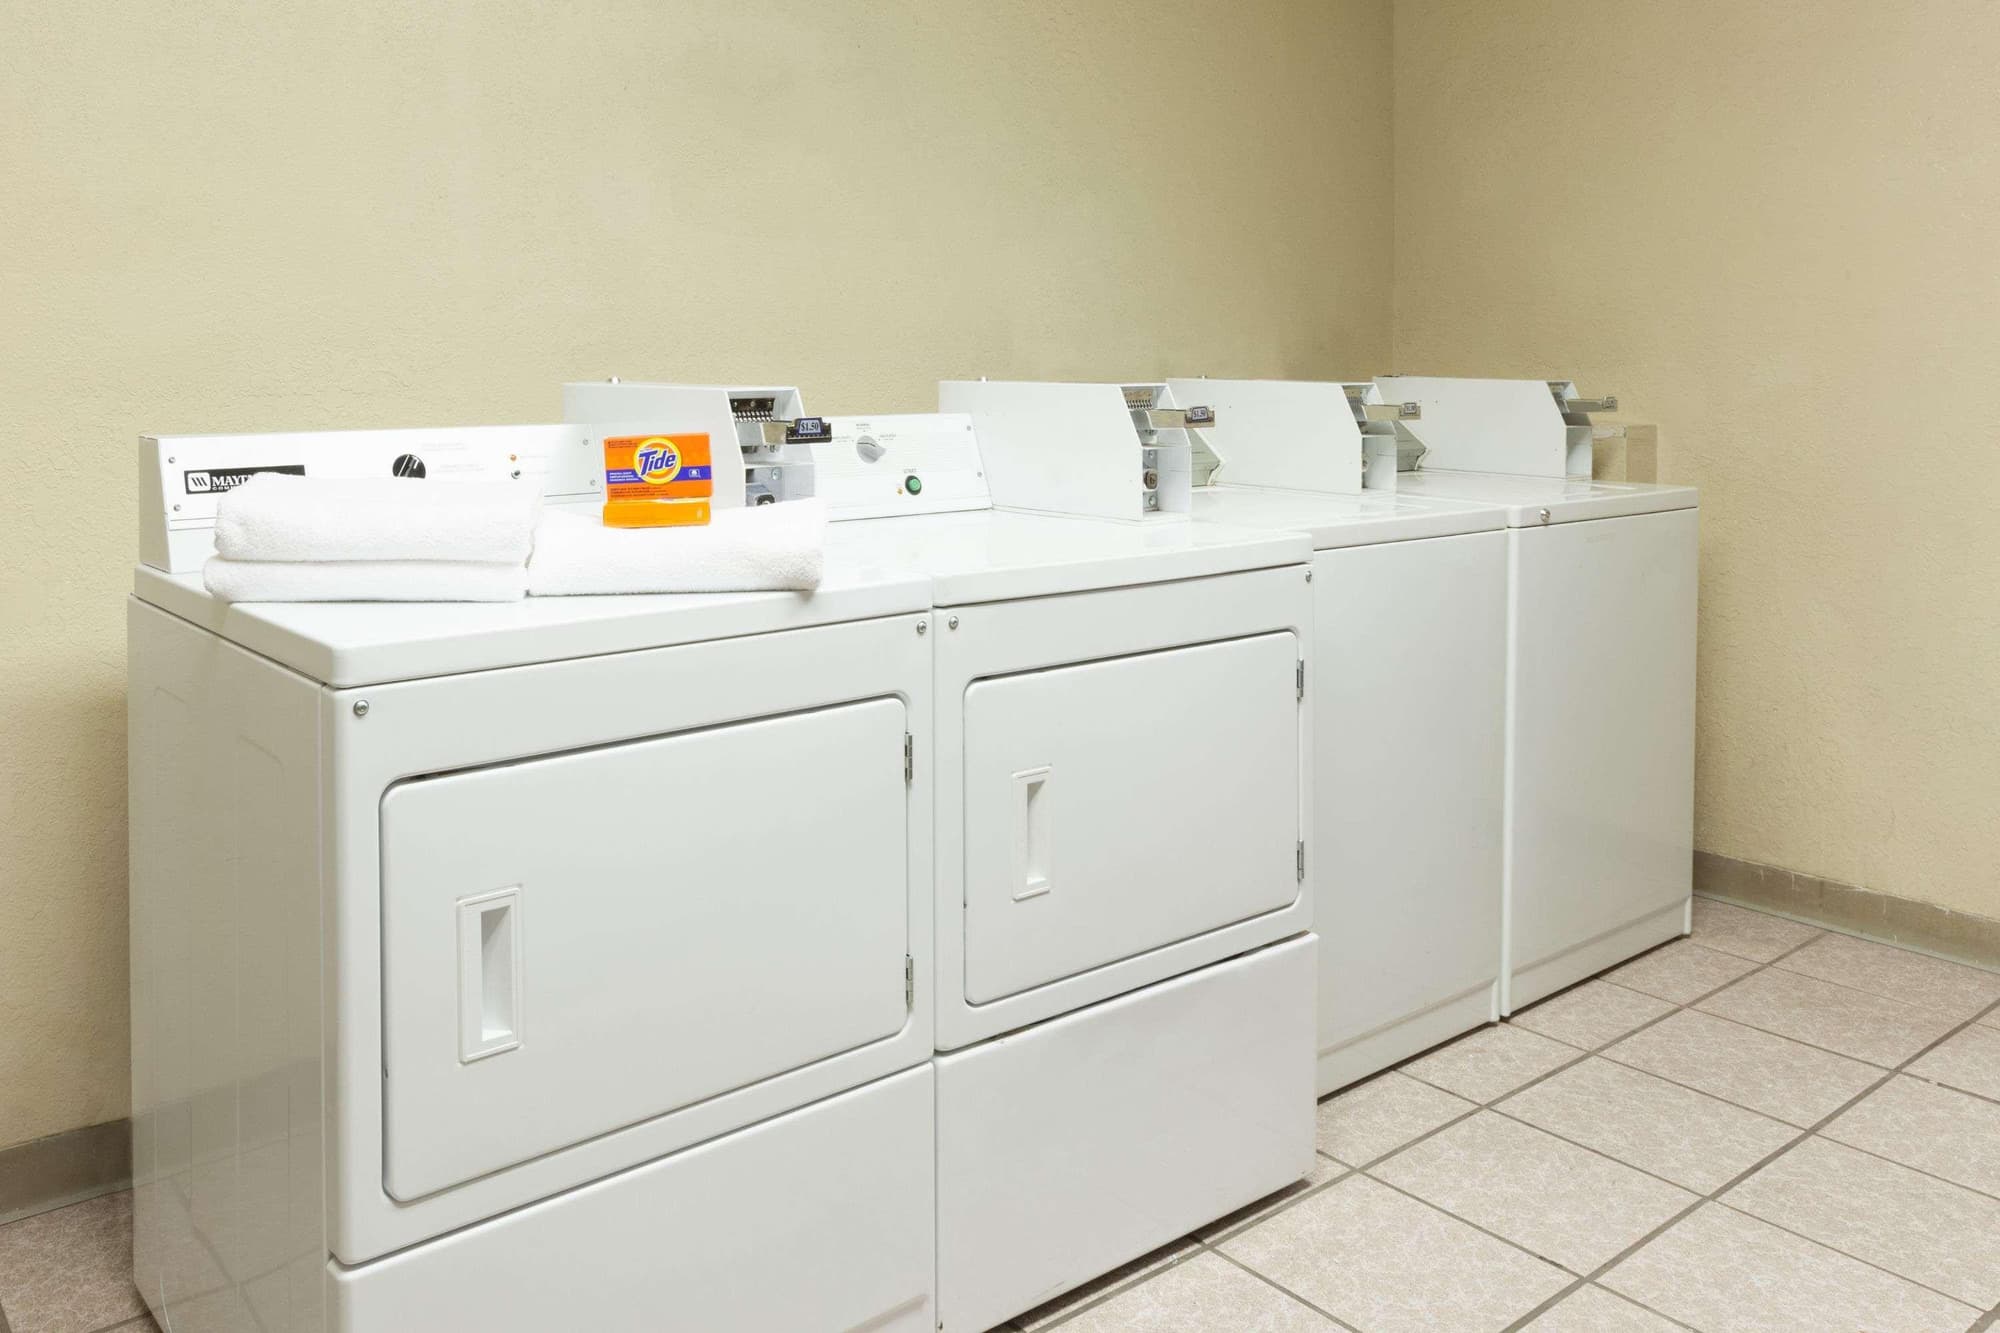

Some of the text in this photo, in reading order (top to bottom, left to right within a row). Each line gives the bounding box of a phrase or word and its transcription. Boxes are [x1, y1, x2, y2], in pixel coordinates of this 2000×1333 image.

[800, 421, 819, 432] $1.50
[638, 449, 677, 476] Tide
[211, 474, 250, 487] MAYT
